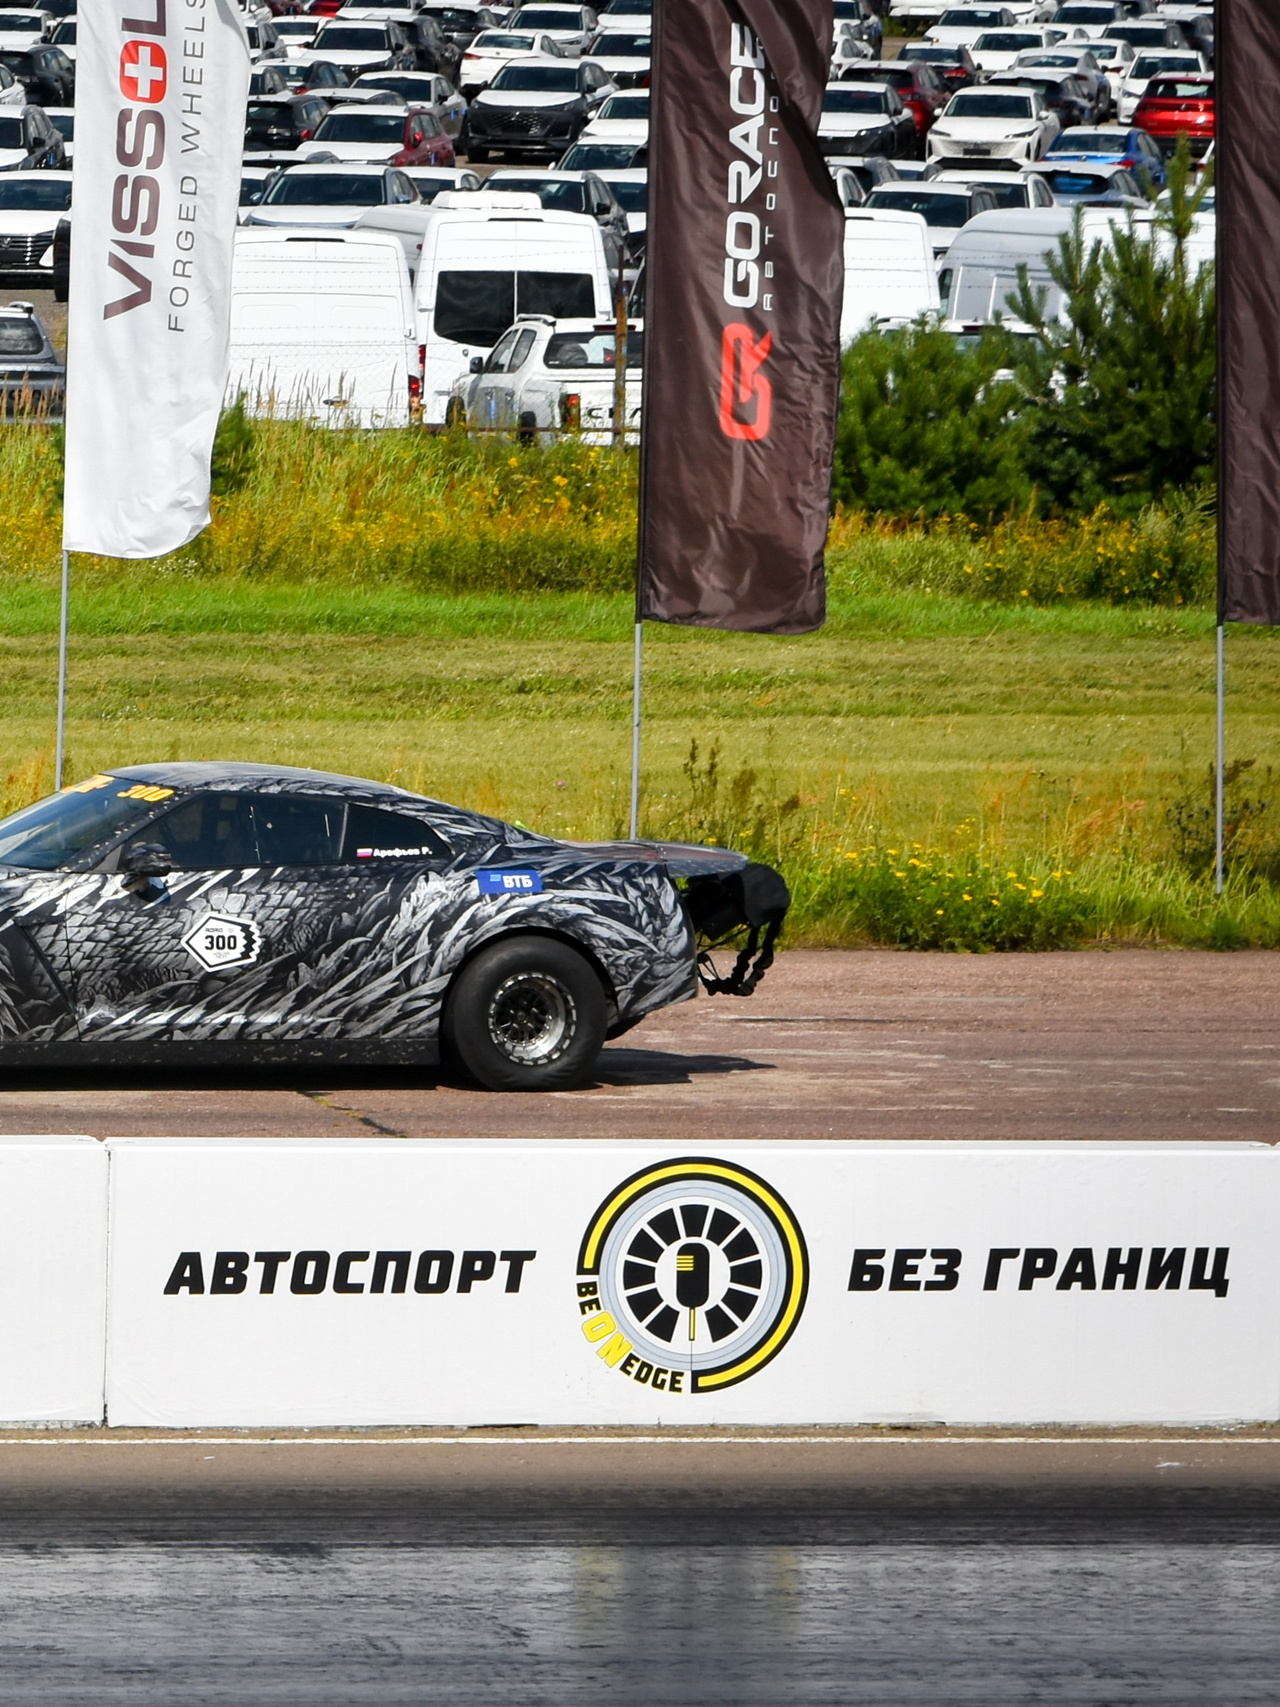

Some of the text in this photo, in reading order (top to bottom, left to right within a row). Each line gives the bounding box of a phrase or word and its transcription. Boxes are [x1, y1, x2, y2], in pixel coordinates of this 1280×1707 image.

[168, 175, 198, 333] FORGED
[502, 875, 533, 888] ВТБ
[204, 935, 237, 950] 300
[163, 1250, 537, 1295] АВТОСПОРТ
[848, 1246, 1231, 1298] БЕЗ ГРАНИЦ
